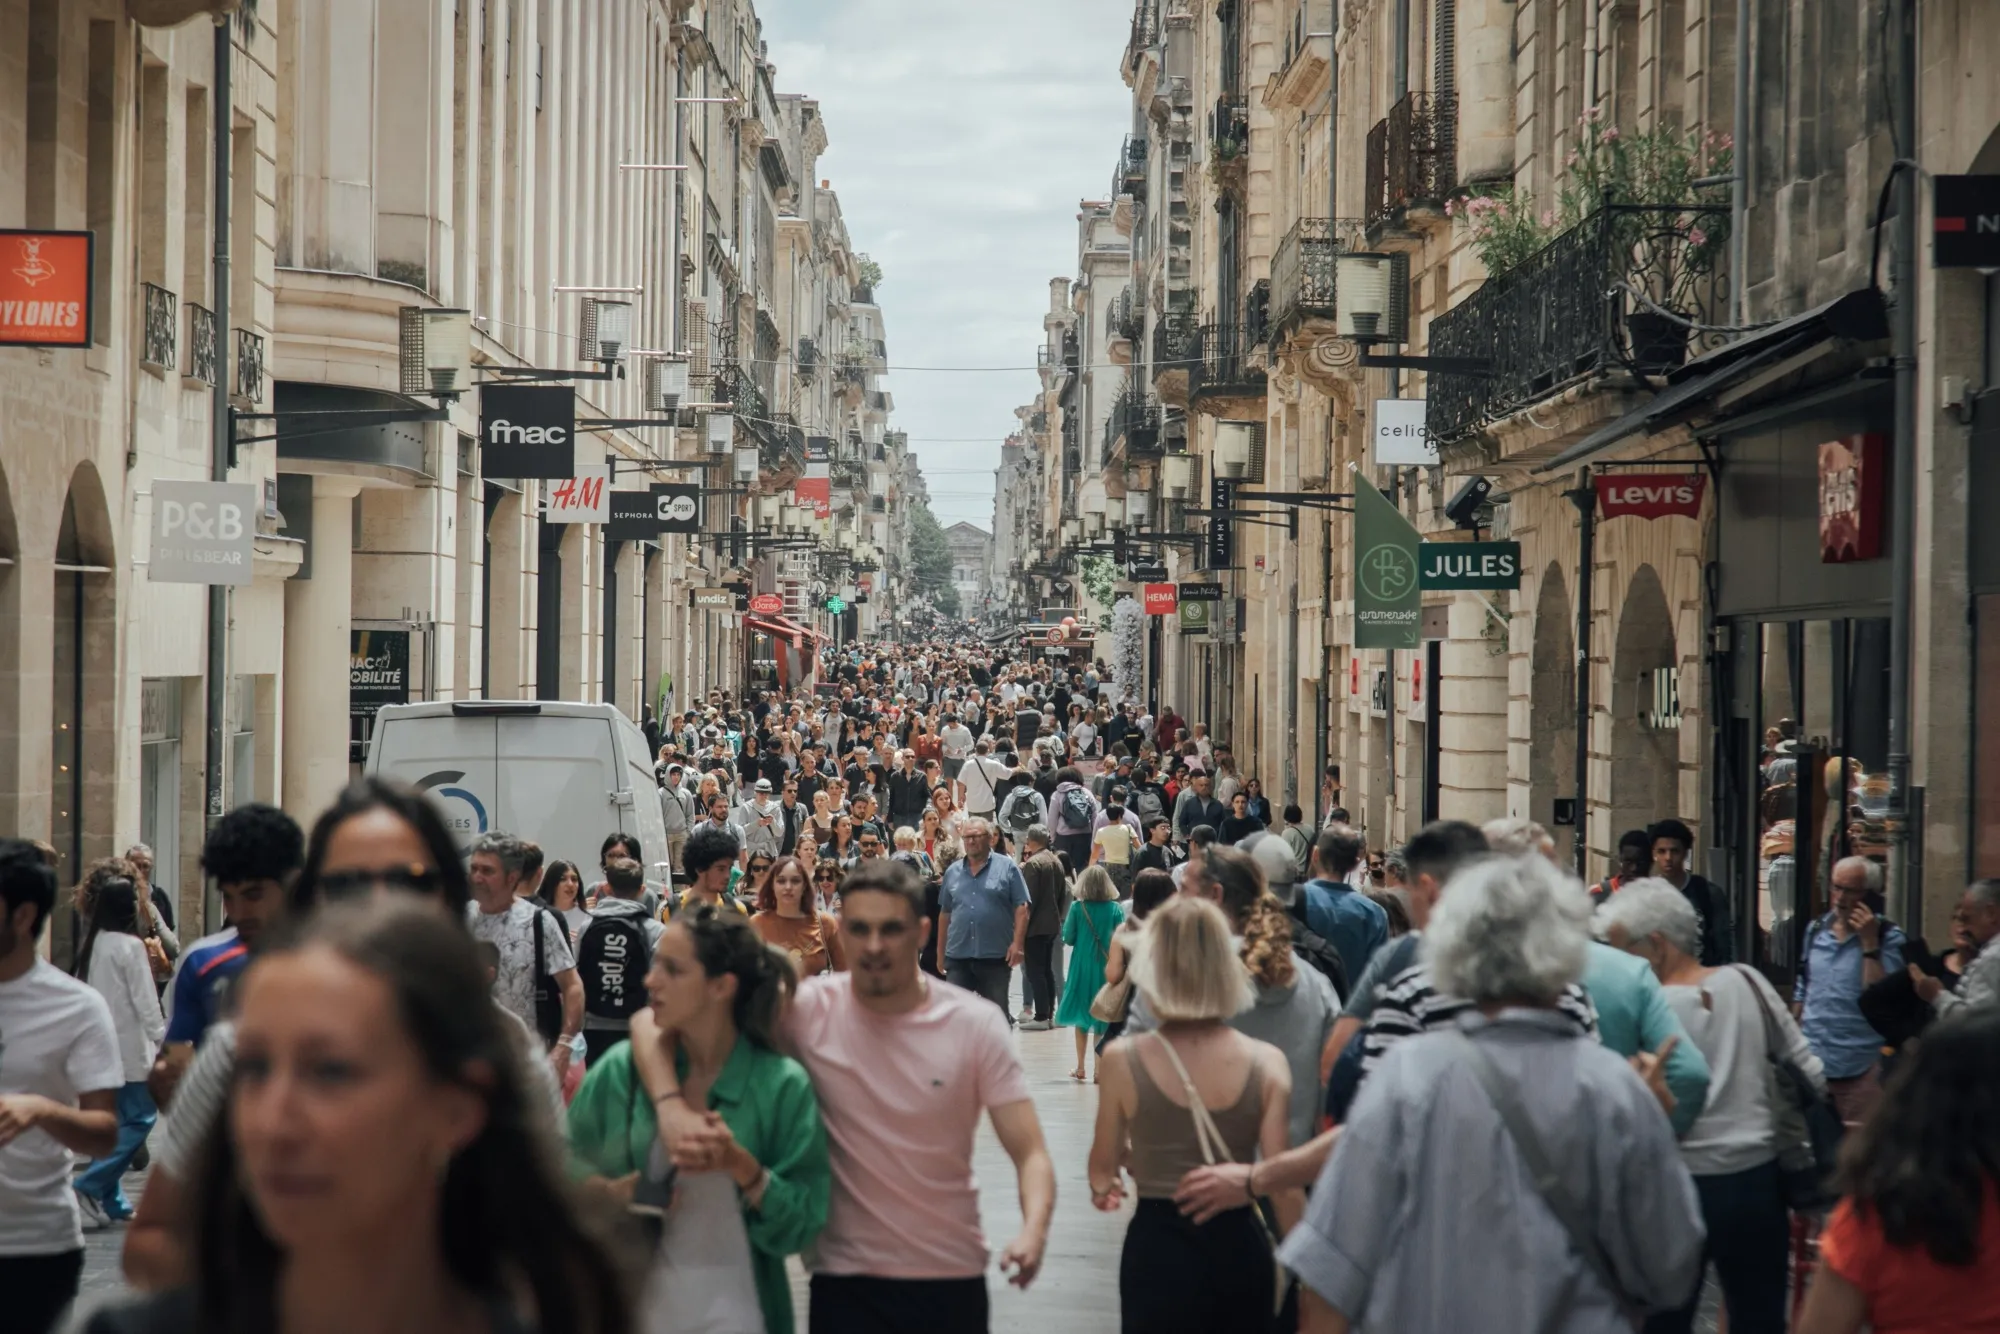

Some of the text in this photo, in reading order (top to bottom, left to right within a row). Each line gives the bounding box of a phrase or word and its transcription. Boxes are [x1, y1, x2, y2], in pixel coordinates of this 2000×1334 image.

[0, 300, 79, 327] YLONES
[489, 419, 566, 444] fnac
[552, 476, 604, 511] H&M
[673, 504, 693, 512] SPORT
[161, 500, 243, 540] P&B
[1424, 554, 1515, 578] JULES
[696, 594, 727, 604] undiz
[1146, 593, 1174, 602] HEMA
[1358, 609, 1417, 621] promenade
[350, 657, 375, 669] NAC
[350, 668, 402, 684] OBILITÉ
